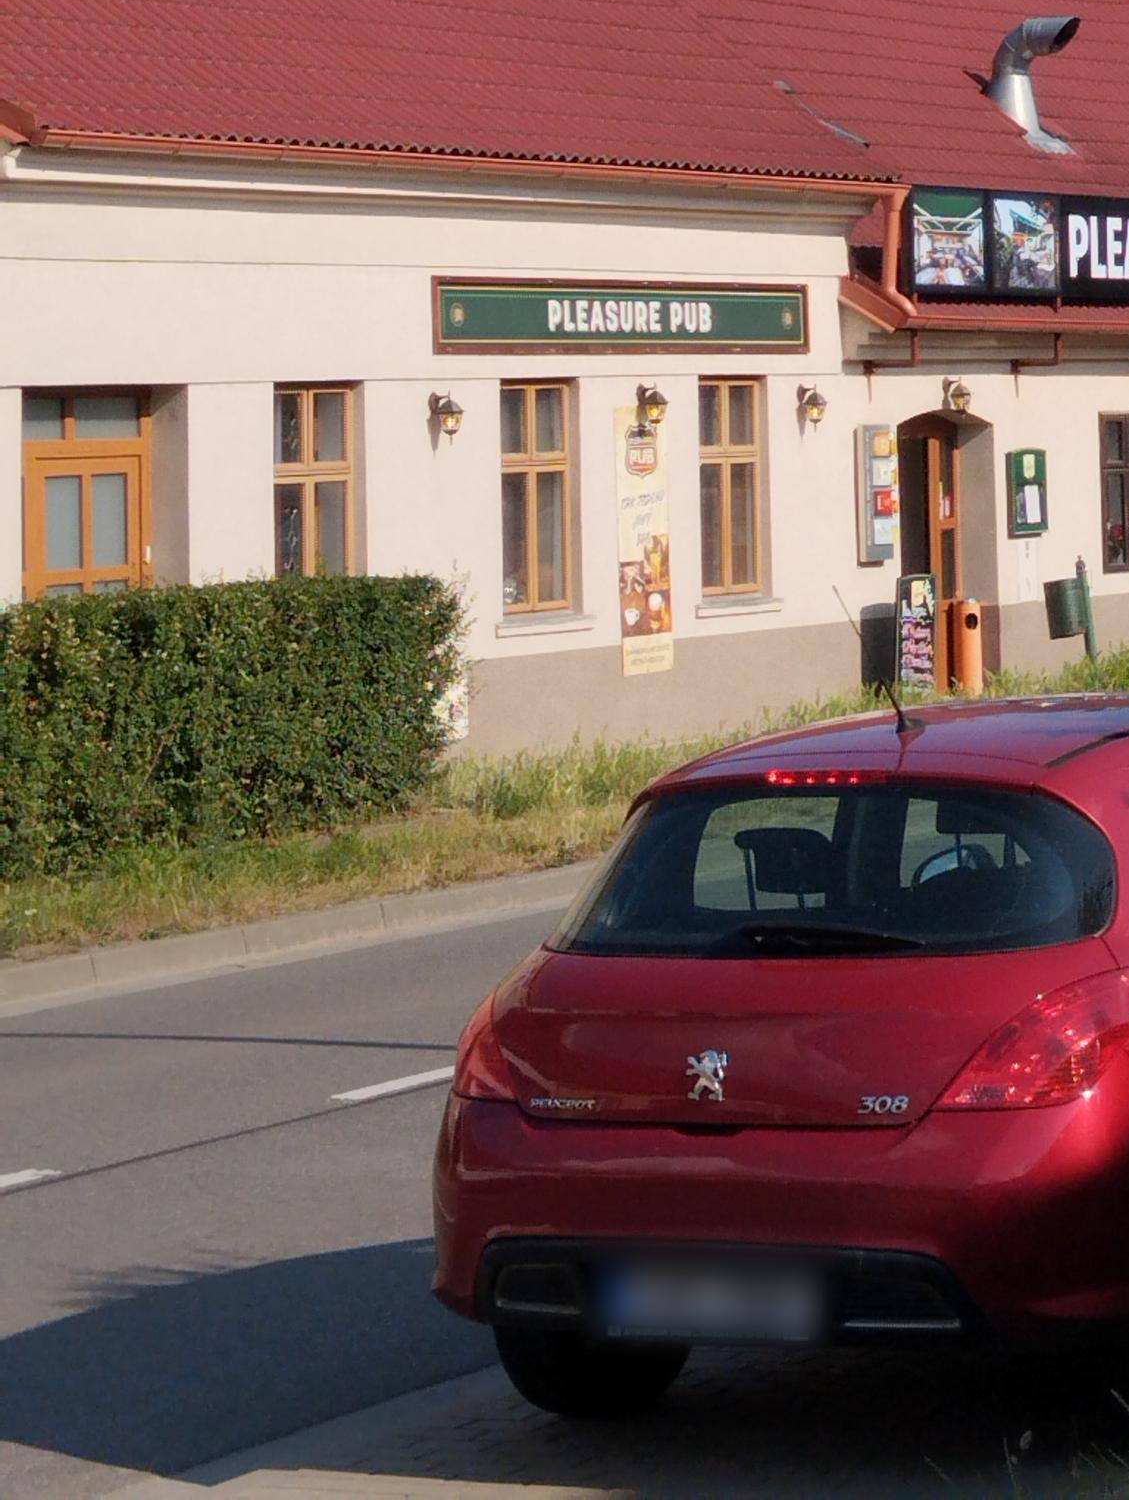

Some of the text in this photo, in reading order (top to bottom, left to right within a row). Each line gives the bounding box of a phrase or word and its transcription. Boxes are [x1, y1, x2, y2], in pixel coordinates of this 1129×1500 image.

[547, 299, 712, 333] PLEASURE PUB
[629, 448, 655, 465] PUB
[529, 1097, 597, 1110] PEUGEOT
[857, 1096, 909, 1114] 308
